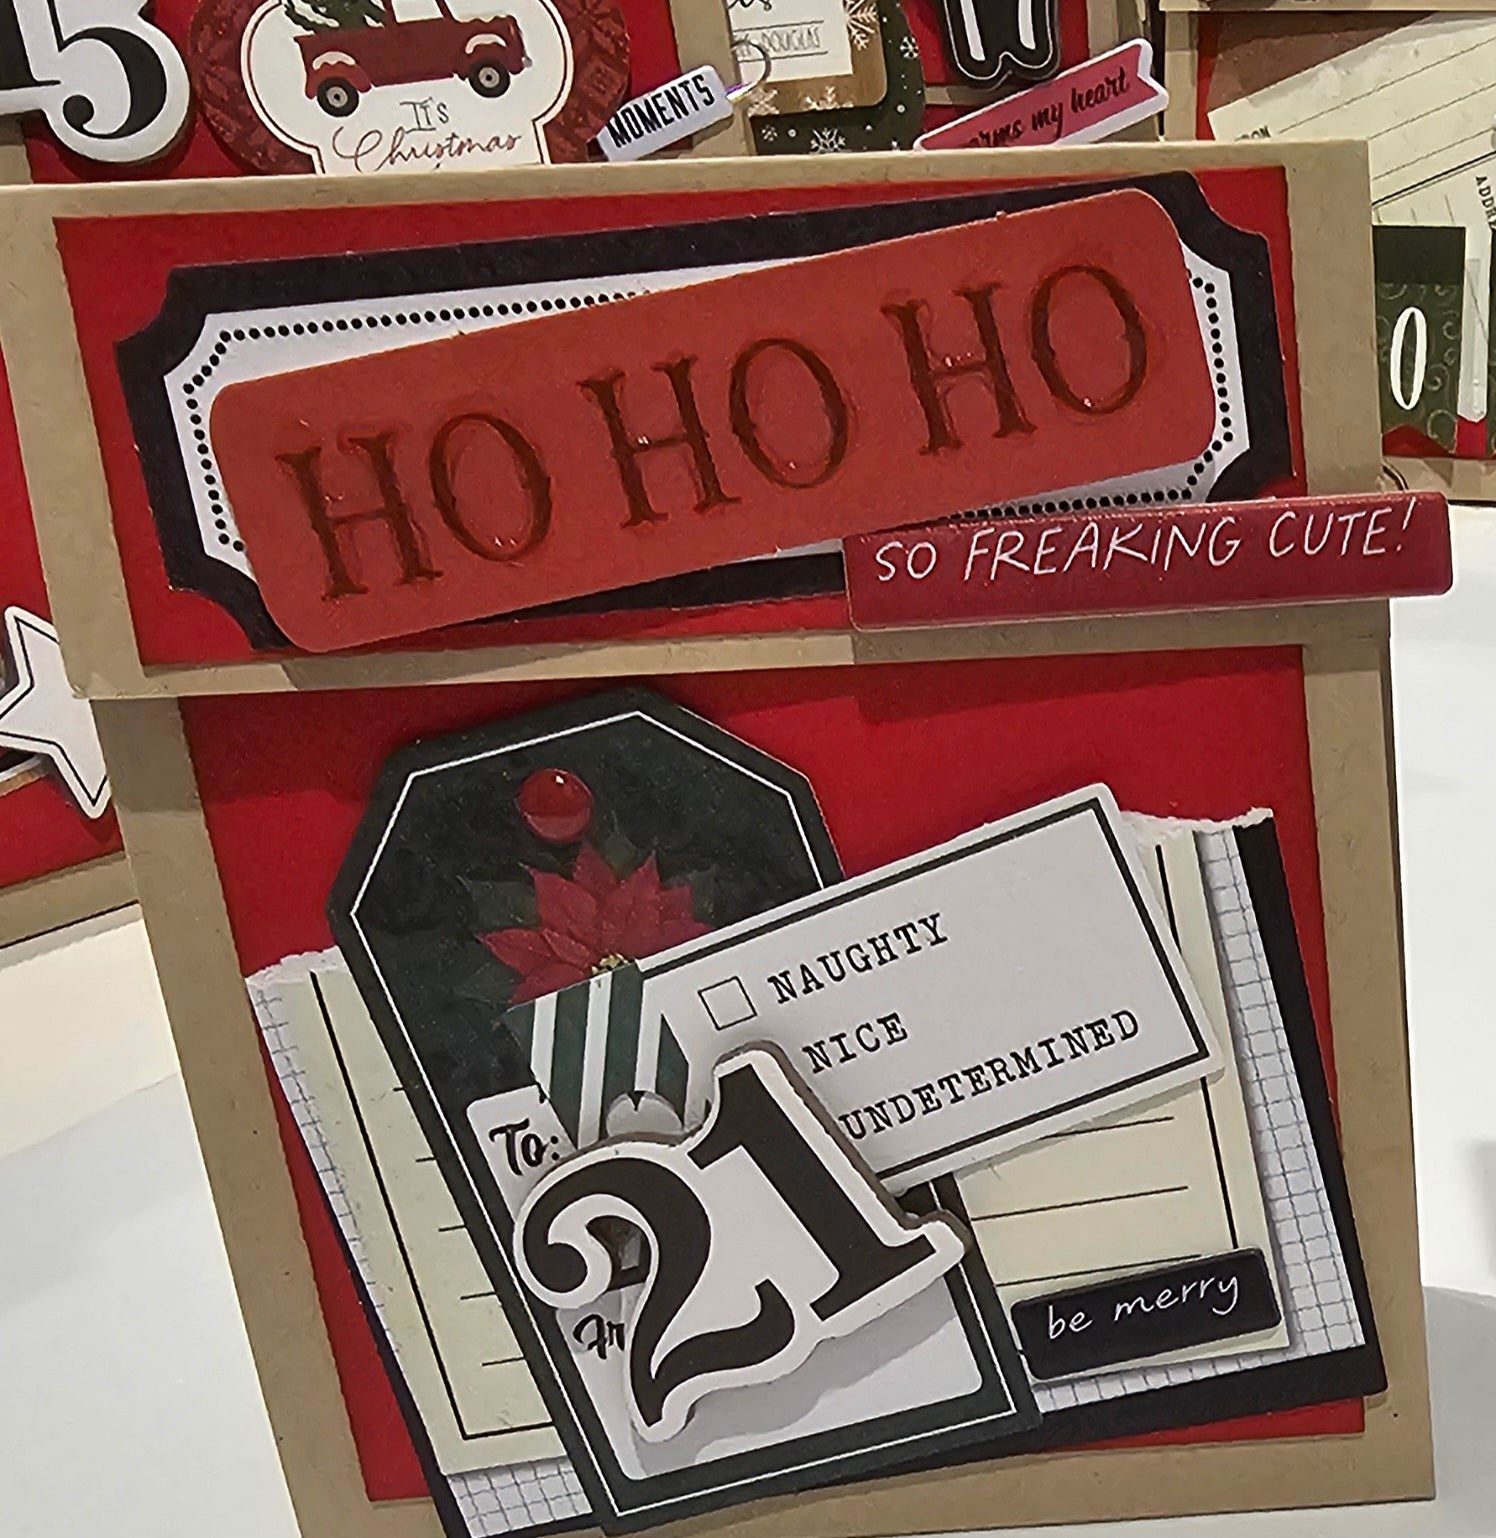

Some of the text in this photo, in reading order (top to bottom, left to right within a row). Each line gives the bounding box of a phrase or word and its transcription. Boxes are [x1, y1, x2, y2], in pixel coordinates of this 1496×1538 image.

[606, 74, 715, 148] MOMENTS
[1032, 102, 1064, 139] my
[1071, 67, 1131, 113] heart
[277, 263, 1150, 600] HO HO HO
[875, 496, 1418, 583] SO FREAKING CUTE!
[766, 912, 949, 1004] NAUGHTY
[801, 1012, 909, 1074] NICE
[837, 1008, 1140, 1141] UNDETERMINED
[489, 1119, 561, 1177] To:
[522, 1064, 937, 1428] 21
[1047, 1275, 1239, 1340] be merry
